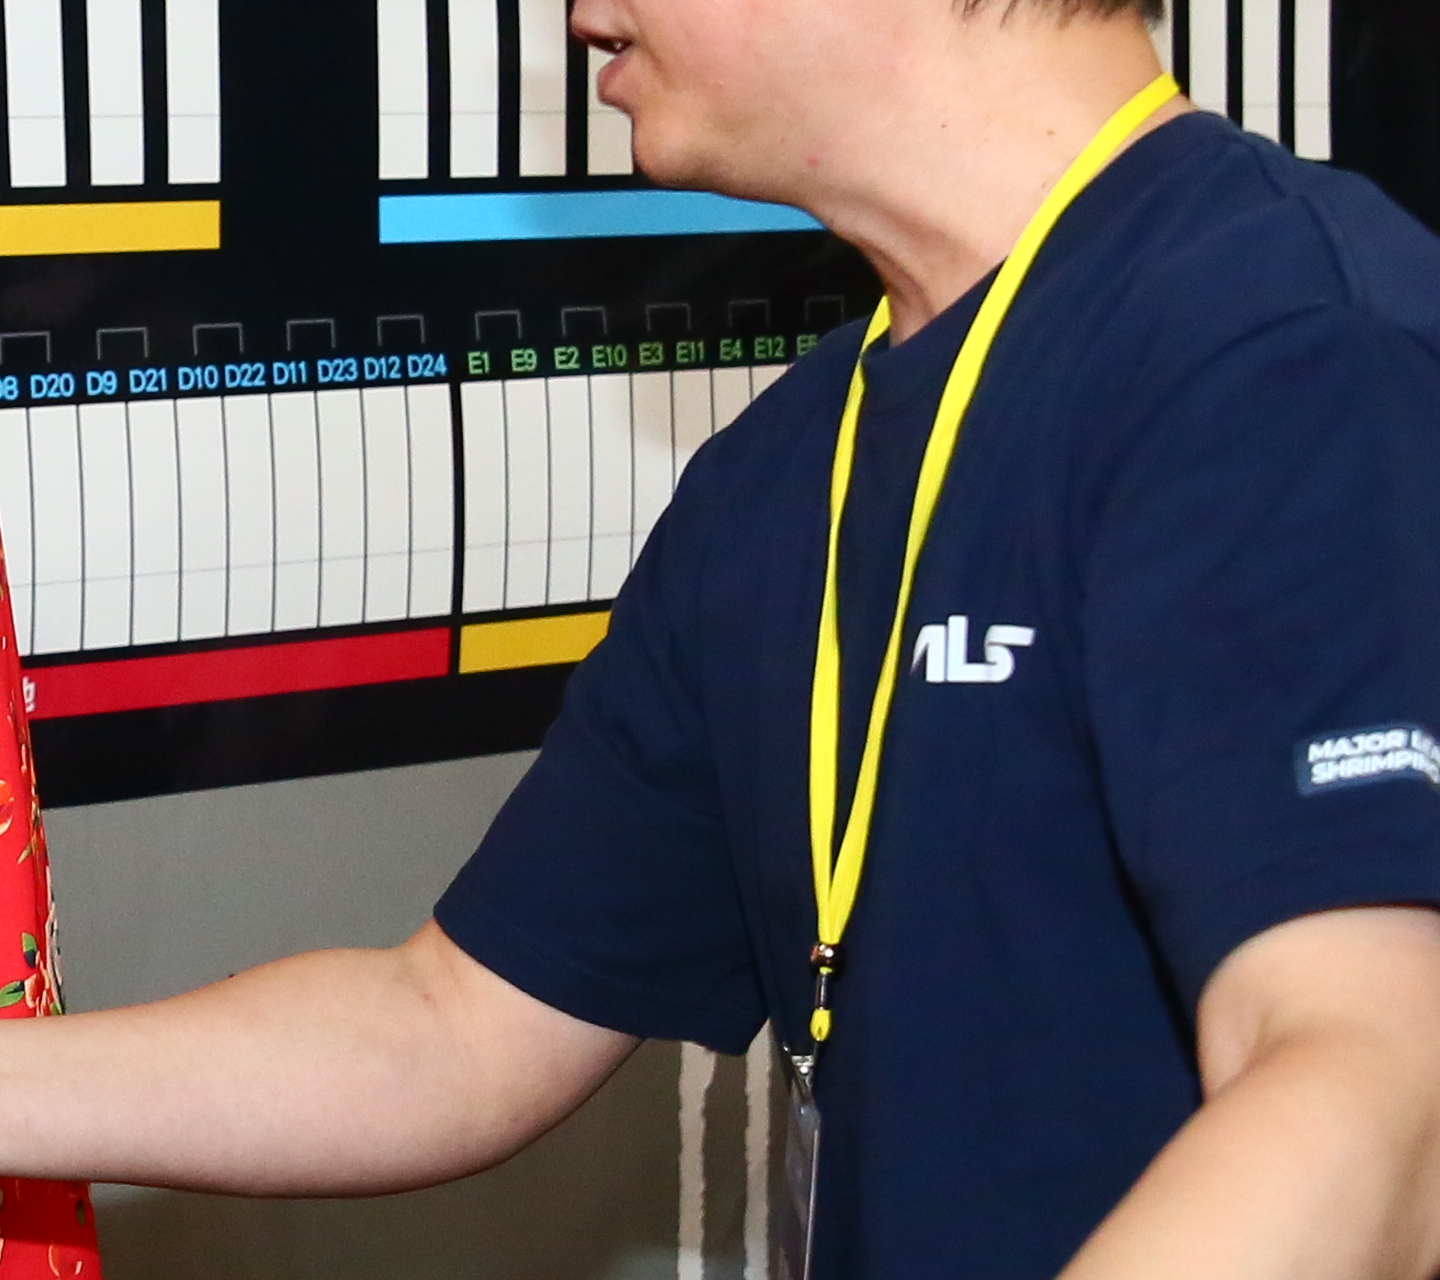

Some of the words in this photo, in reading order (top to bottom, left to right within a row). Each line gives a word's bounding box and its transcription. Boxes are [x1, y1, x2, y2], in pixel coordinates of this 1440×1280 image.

[467, 350, 490, 375] E1
[510, 347, 538, 373] E9
[553, 345, 581, 371] E2
[591, 344, 628, 369] E10
[638, 341, 664, 366] E3
[676, 341, 705, 363] E11
[719, 338, 743, 361] E4
[754, 336, 785, 359] E12
[29, 372, 76, 399] D20
[85, 369, 118, 396] D9
[128, 367, 168, 394] D21
[177, 364, 220, 391] D10
[224, 362, 266, 389] D22
[272, 360, 307, 386] D11
[316, 357, 359, 383] D23
[363, 355, 402, 381] D12
[406, 353, 448, 378] D24
[1307, 728, 1409, 763] MAJOR
